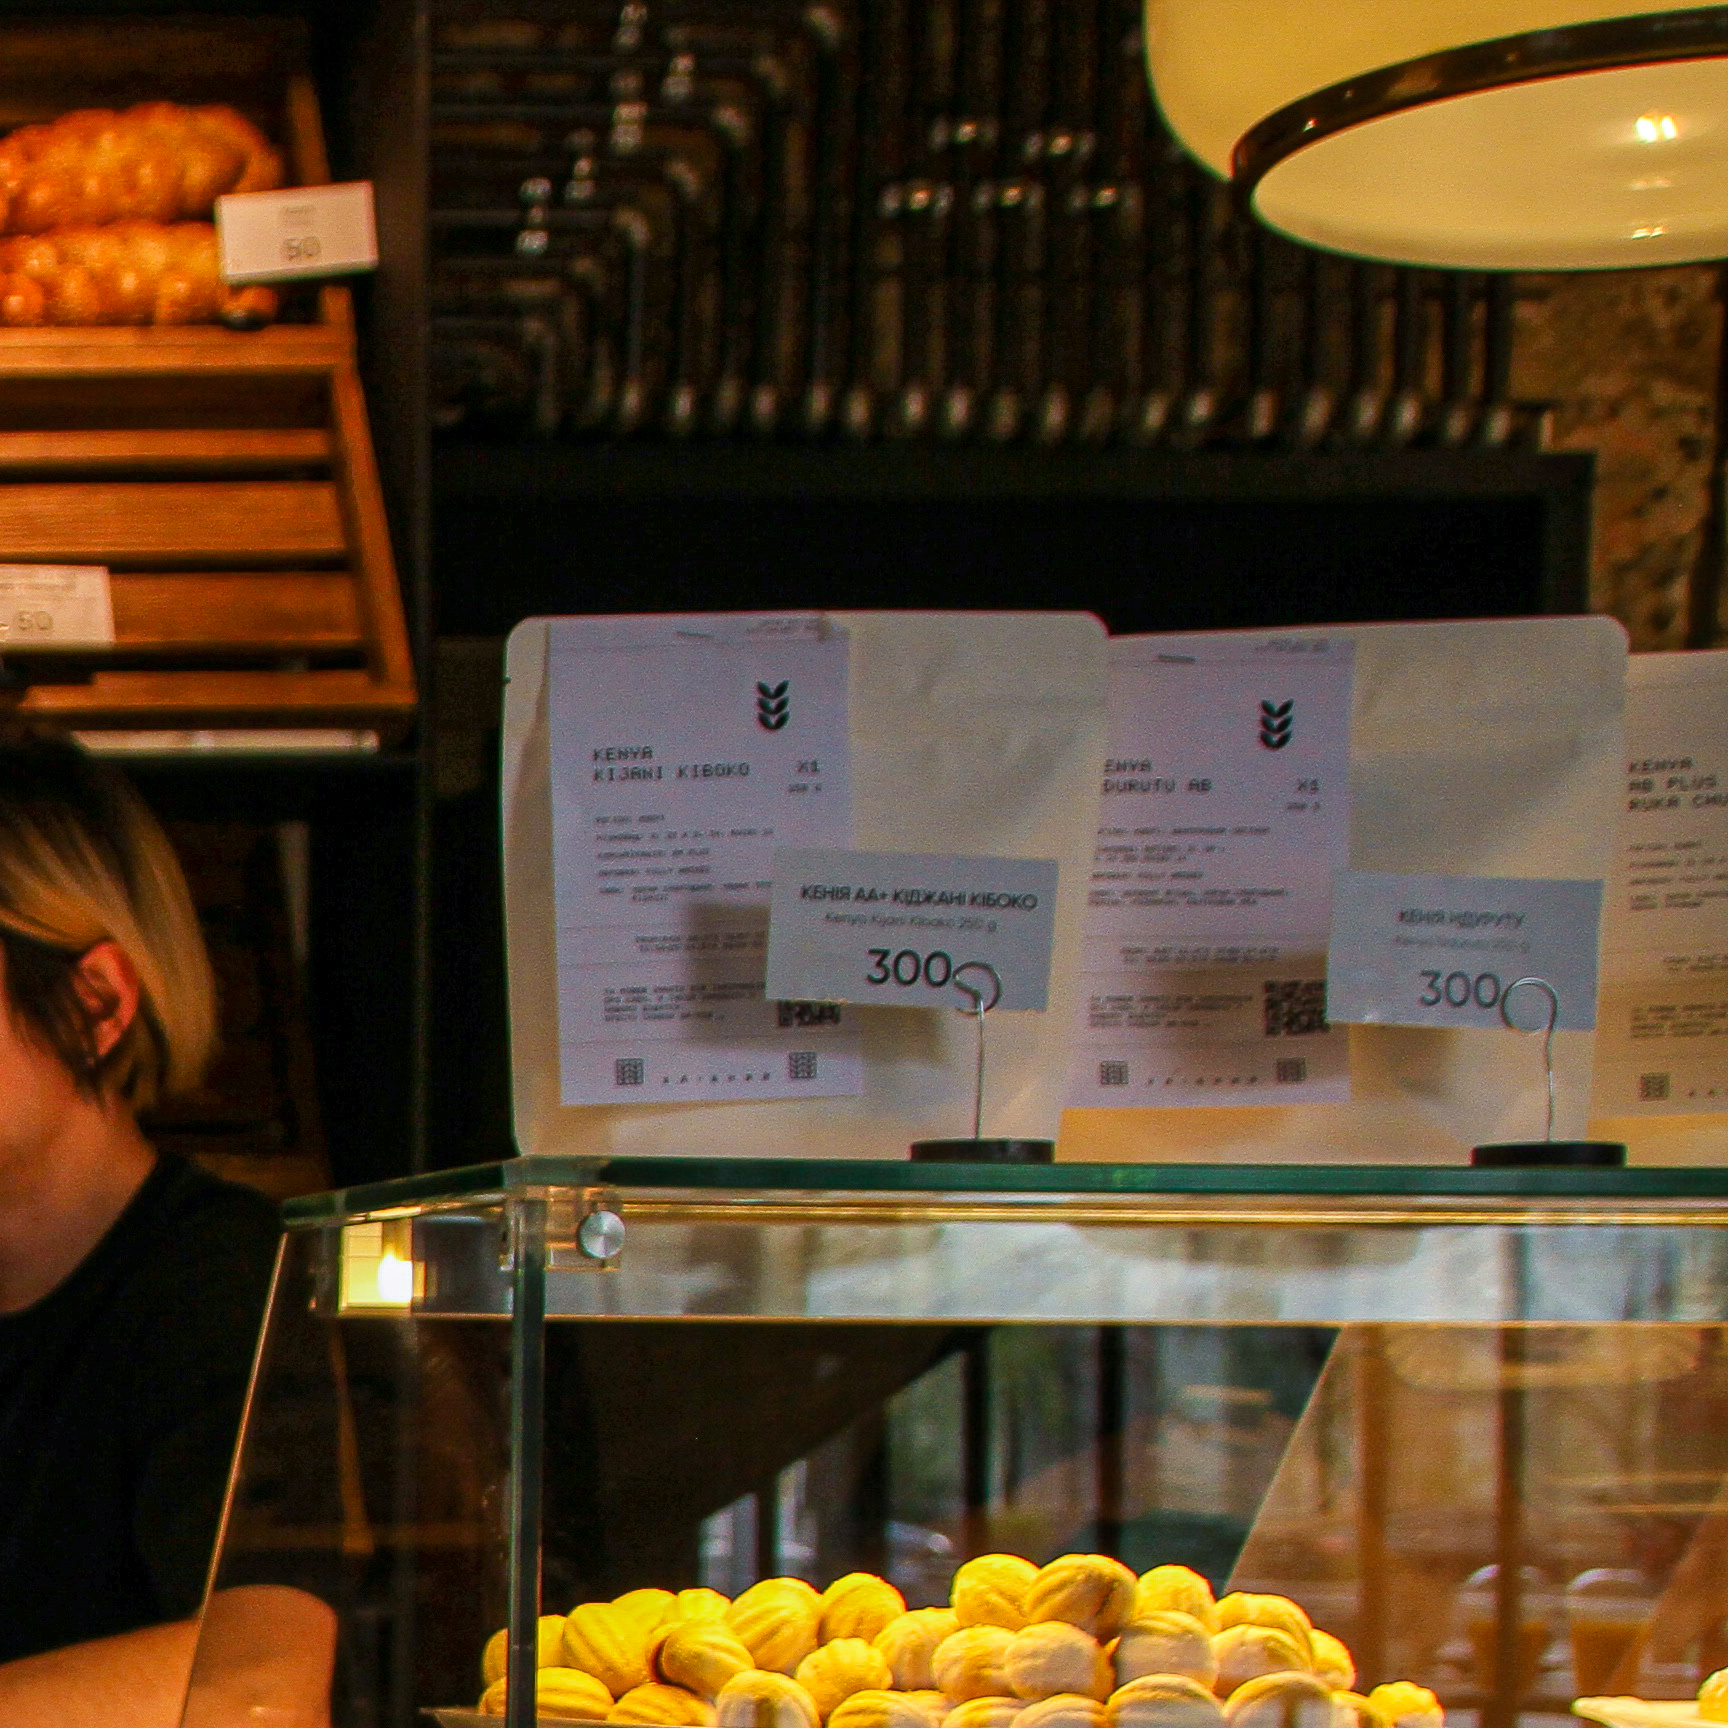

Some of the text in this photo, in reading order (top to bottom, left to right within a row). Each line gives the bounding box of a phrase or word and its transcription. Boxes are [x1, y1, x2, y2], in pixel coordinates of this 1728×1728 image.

[593, 746, 653, 761] KENYA
[594, 762, 750, 781] KIJANI KIBOKO
[1103, 758, 1152, 773] ENYA
[801, 884, 851, 900] КЕНІЯ
[895, 887, 967, 906] КІДЖАНІ
[970, 892, 1039, 910] КІБОКО
[866, 948, 953, 987] 300
[1420, 969, 1501, 1008] 300
